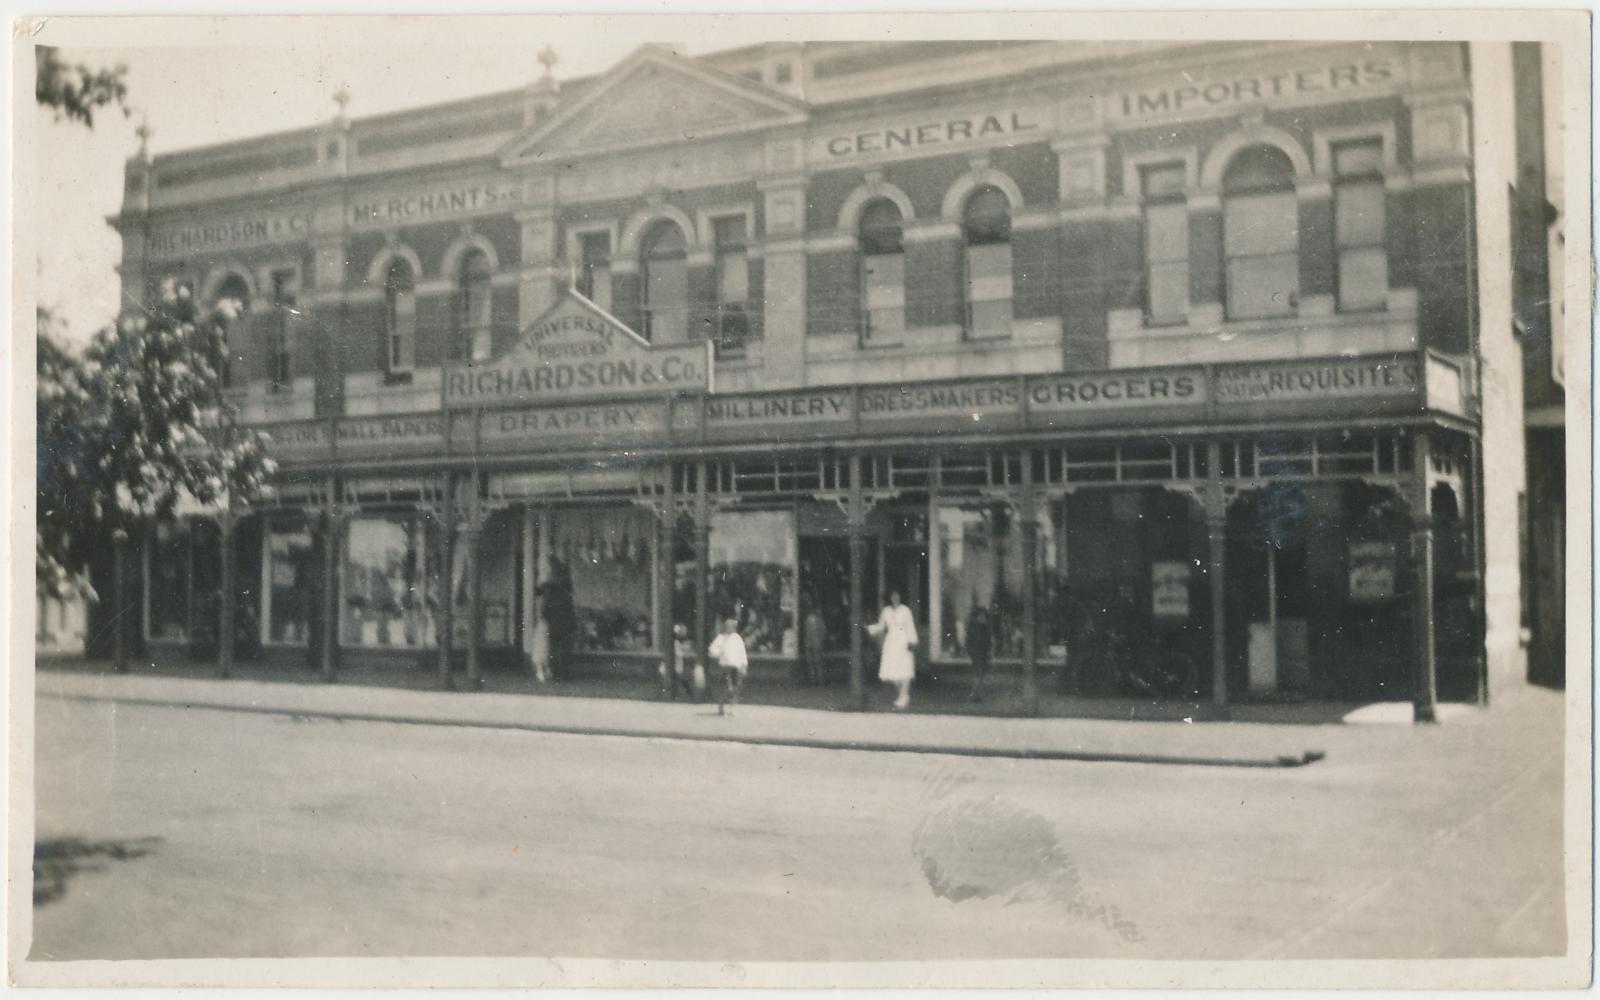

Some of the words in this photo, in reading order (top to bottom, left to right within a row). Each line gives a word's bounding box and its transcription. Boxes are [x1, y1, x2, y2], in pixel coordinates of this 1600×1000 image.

[1122, 60, 1393, 117] IMPORTERS
[827, 112, 1038, 156] GENERAL
[352, 184, 498, 223] MERCHANTS
[150, 217, 268, 252] RICHARDSON
[524, 314, 615, 350] UNIVERSAL
[448, 359, 637, 396] RICHARDSON
[641, 367, 658, 383] &
[1032, 376, 1195, 404] GROCERS
[1269, 365, 1418, 392] REQUISITES
[707, 395, 847, 421] MILLINERY
[861, 384, 1019, 413] DRESSMAKERS
[500, 408, 640, 432] DRAPERY
